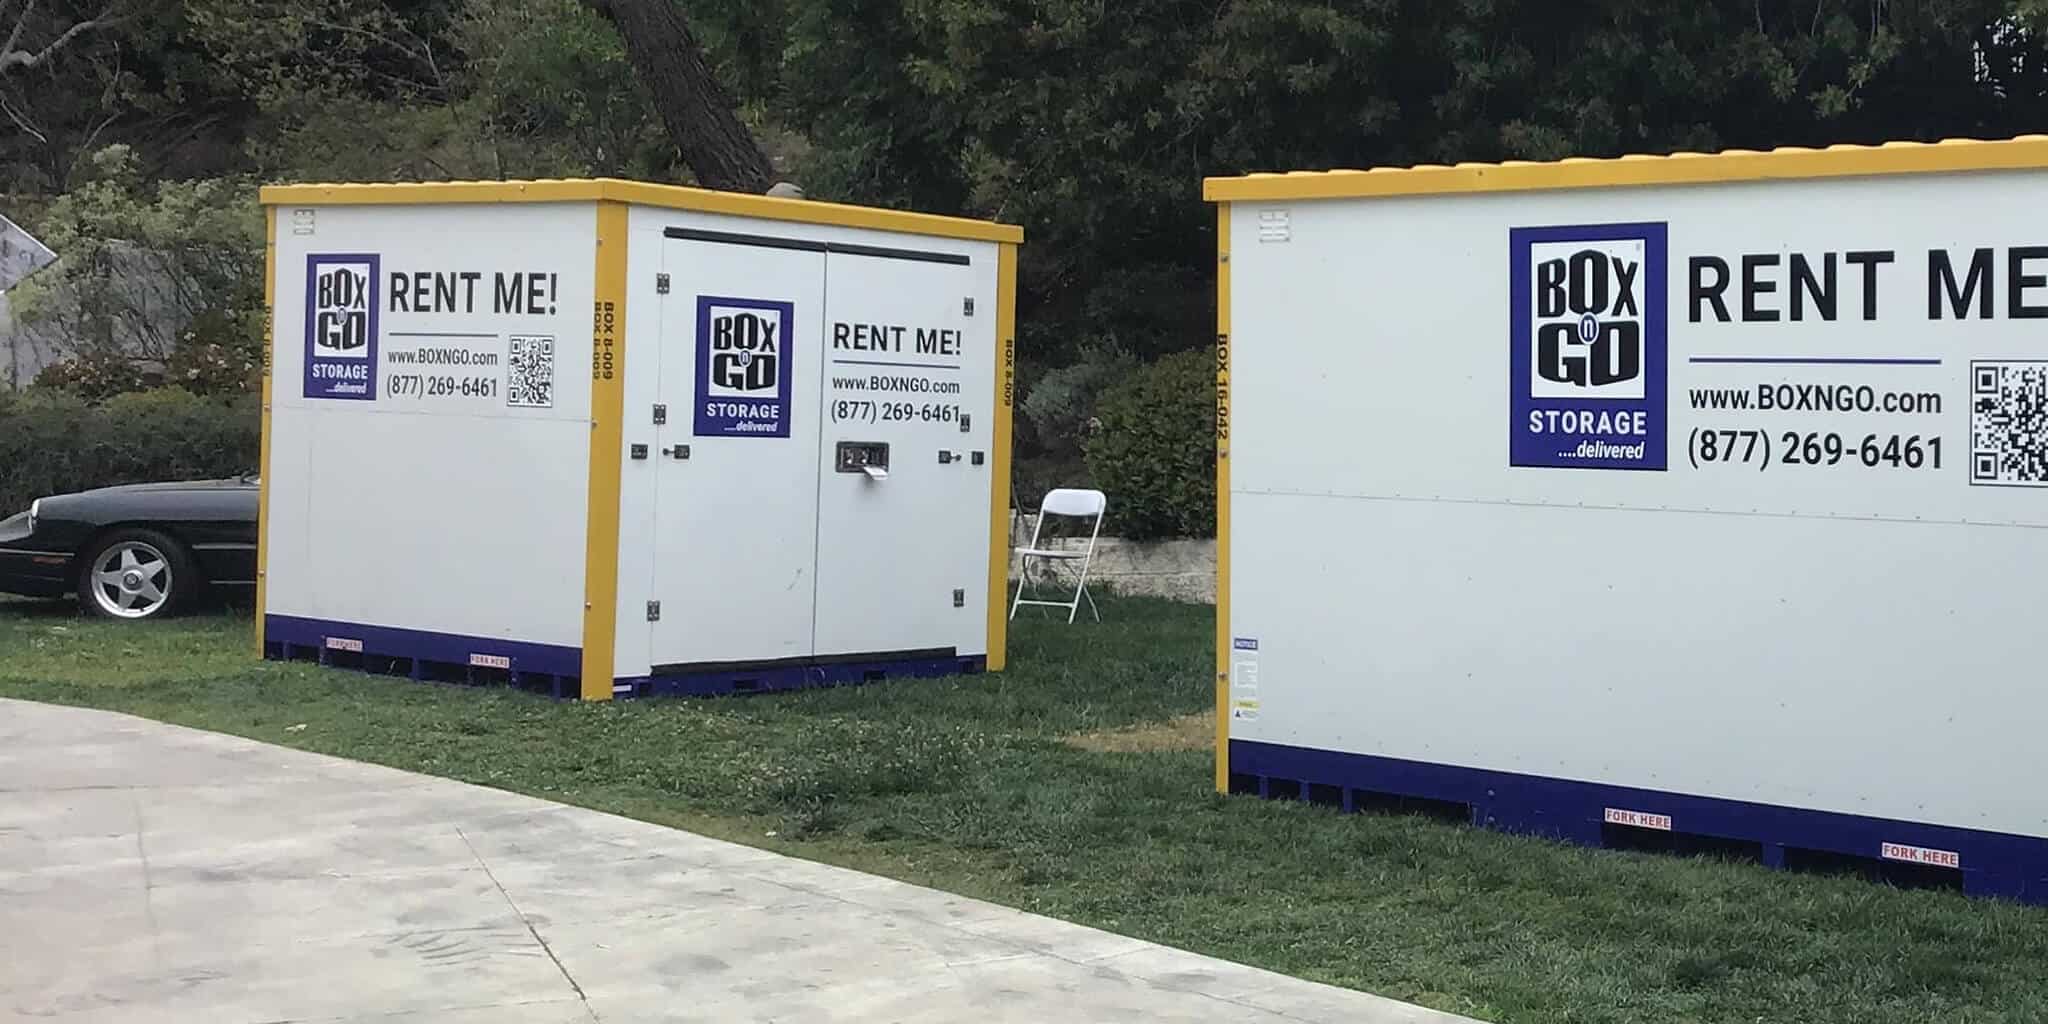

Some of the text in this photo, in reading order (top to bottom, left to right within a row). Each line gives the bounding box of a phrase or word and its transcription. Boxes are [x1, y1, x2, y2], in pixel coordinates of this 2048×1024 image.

[319, 268, 367, 309] BOX
[390, 272, 557, 315] RENT ME!
[1537, 249, 1639, 318] BOX
[1688, 250, 1895, 323] RENT
[318, 311, 366, 350] GO
[603, 302, 614, 380] BOX 8-009
[714, 313, 776, 352] BOX
[833, 322, 961, 355] RENT ME!
[1583, 319, 1595, 339] n
[387, 348, 498, 366] www.BOXNGO.com
[1538, 321, 1639, 387] GO
[312, 364, 368, 379] STORAGE
[387, 374, 497, 399] (877) 269-6461
[713, 353, 776, 391] GO
[832, 376, 960, 394] www.BOXNGO.com
[1218, 334, 1228, 440] BOX 16-042
[706, 403, 779, 418] STORAGE
[831, 399, 960, 425] (877) 269-6461
[1689, 384, 1942, 413] www.BOXNGO.com
[1529, 411, 1647, 435] STORAGE
[1558, 441, 1645, 459] ....delivered
[1688, 427, 1942, 472] (877) 269-6461
[1607, 810, 1670, 828] FORK HERE
[1884, 845, 1957, 865] FORK HERE
